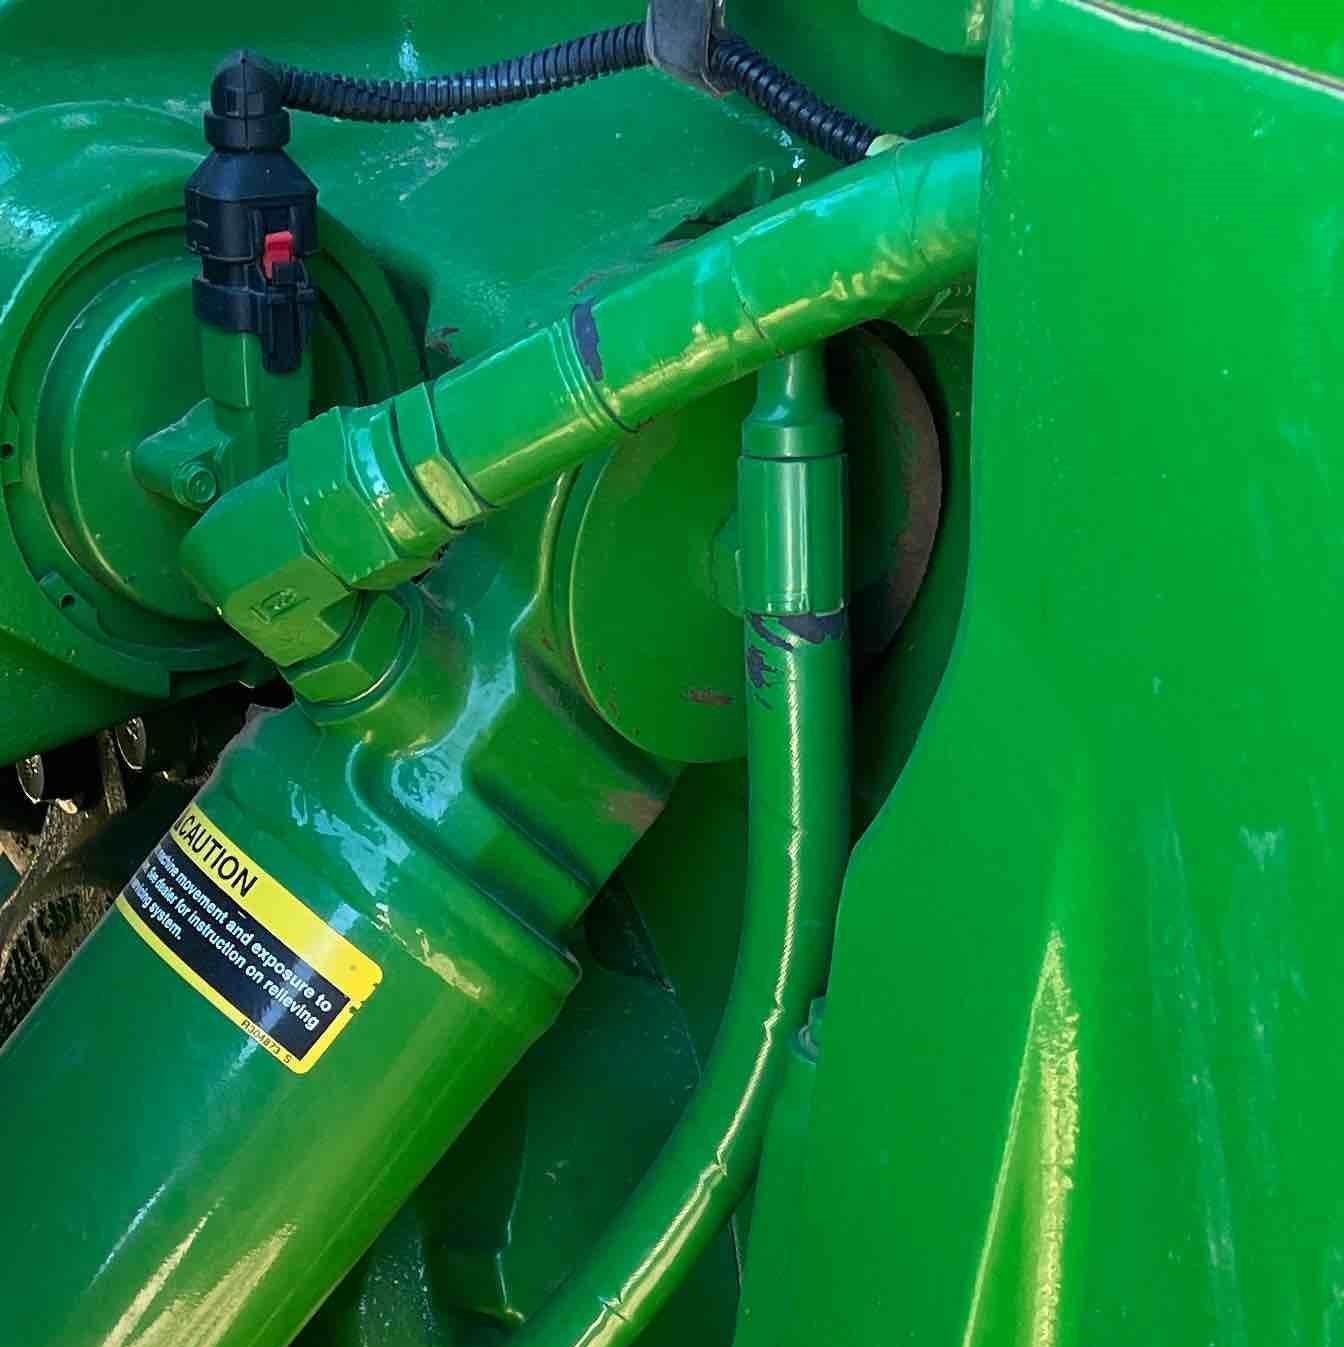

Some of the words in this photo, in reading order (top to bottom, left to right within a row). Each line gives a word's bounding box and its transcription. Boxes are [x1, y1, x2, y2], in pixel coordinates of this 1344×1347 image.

[178, 815, 257, 897] CAUTION
[148, 902, 181, 940] system.
[174, 898, 191, 916] for
[187, 910, 258, 978] instruction
[245, 965, 264, 983] on
[262, 979, 319, 1030] relieving
[175, 872, 228, 924] movement
[225, 920, 254, 945] and
[251, 942, 315, 998] exposure
[314, 993, 332, 1012] to
